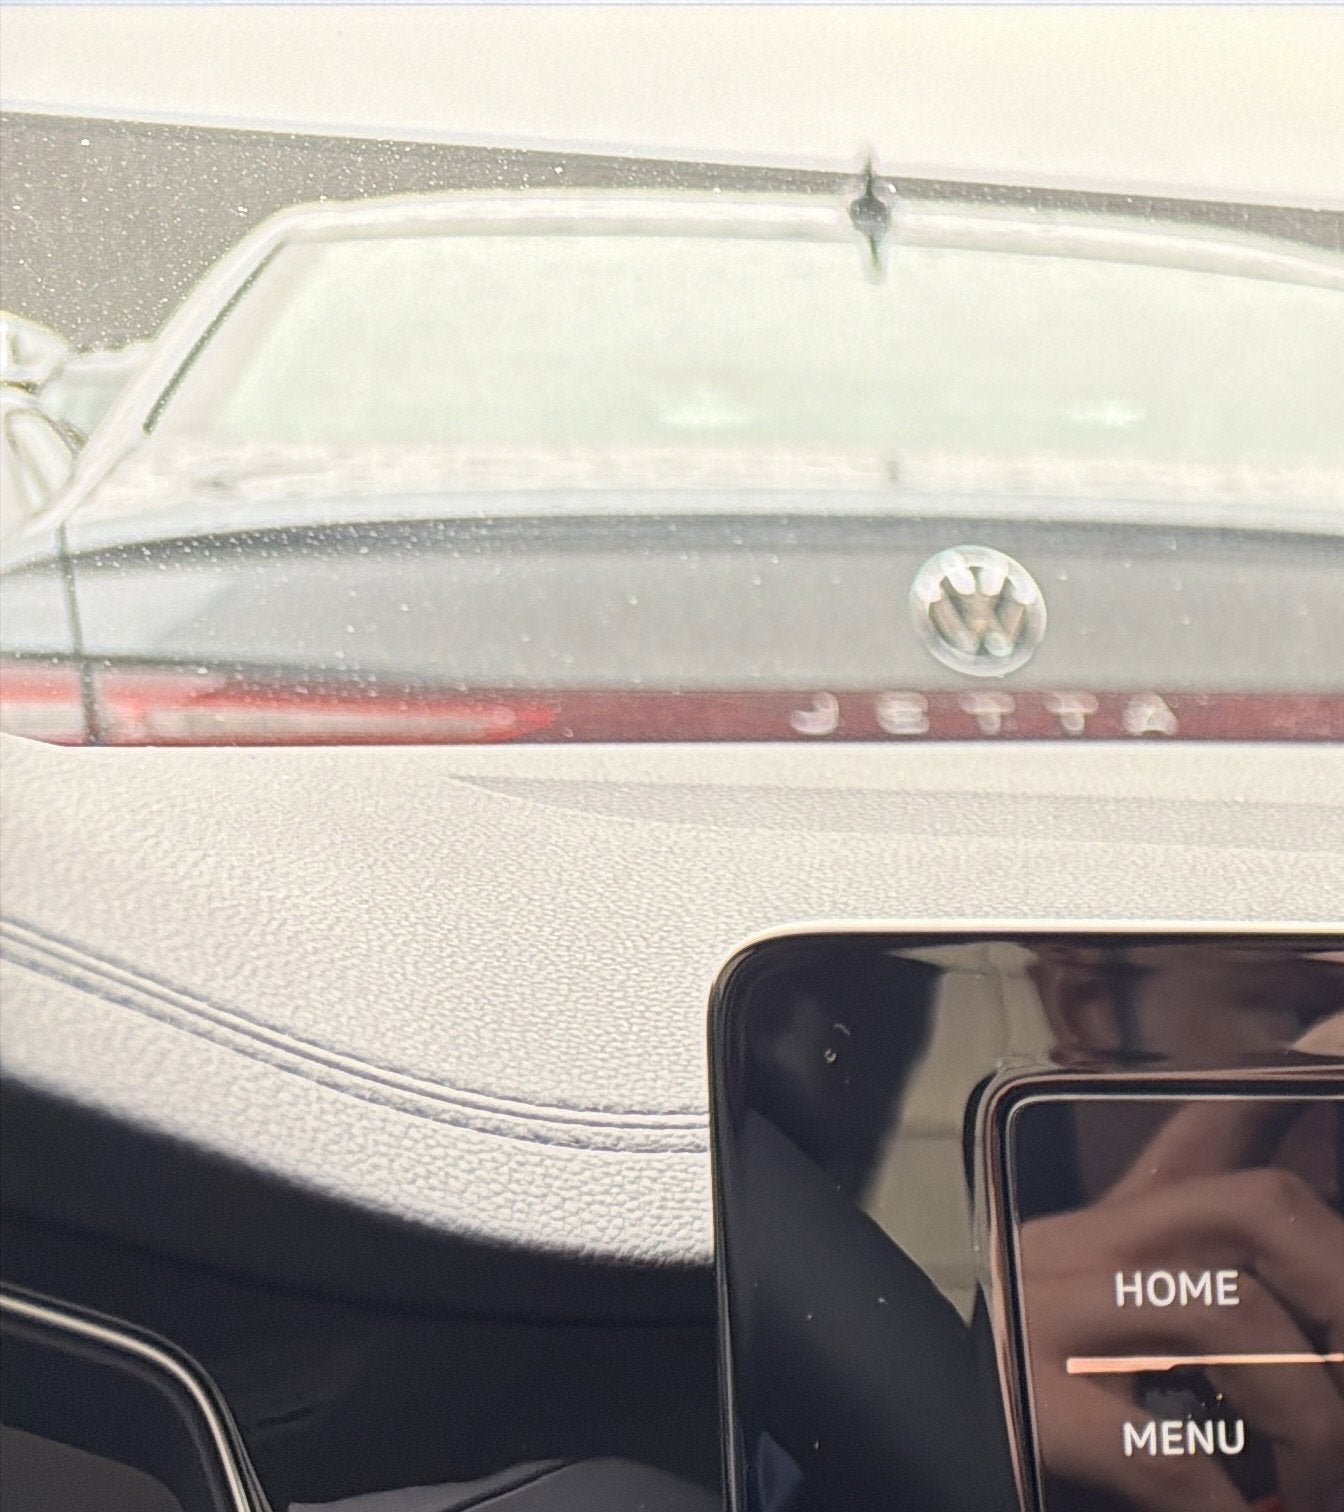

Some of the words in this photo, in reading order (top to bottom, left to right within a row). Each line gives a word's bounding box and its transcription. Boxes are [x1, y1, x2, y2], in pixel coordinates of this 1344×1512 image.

[790, 692, 1180, 735] JETTA
[1114, 1270, 1240, 1307] HOME
[1123, 1420, 1246, 1457] MENU
